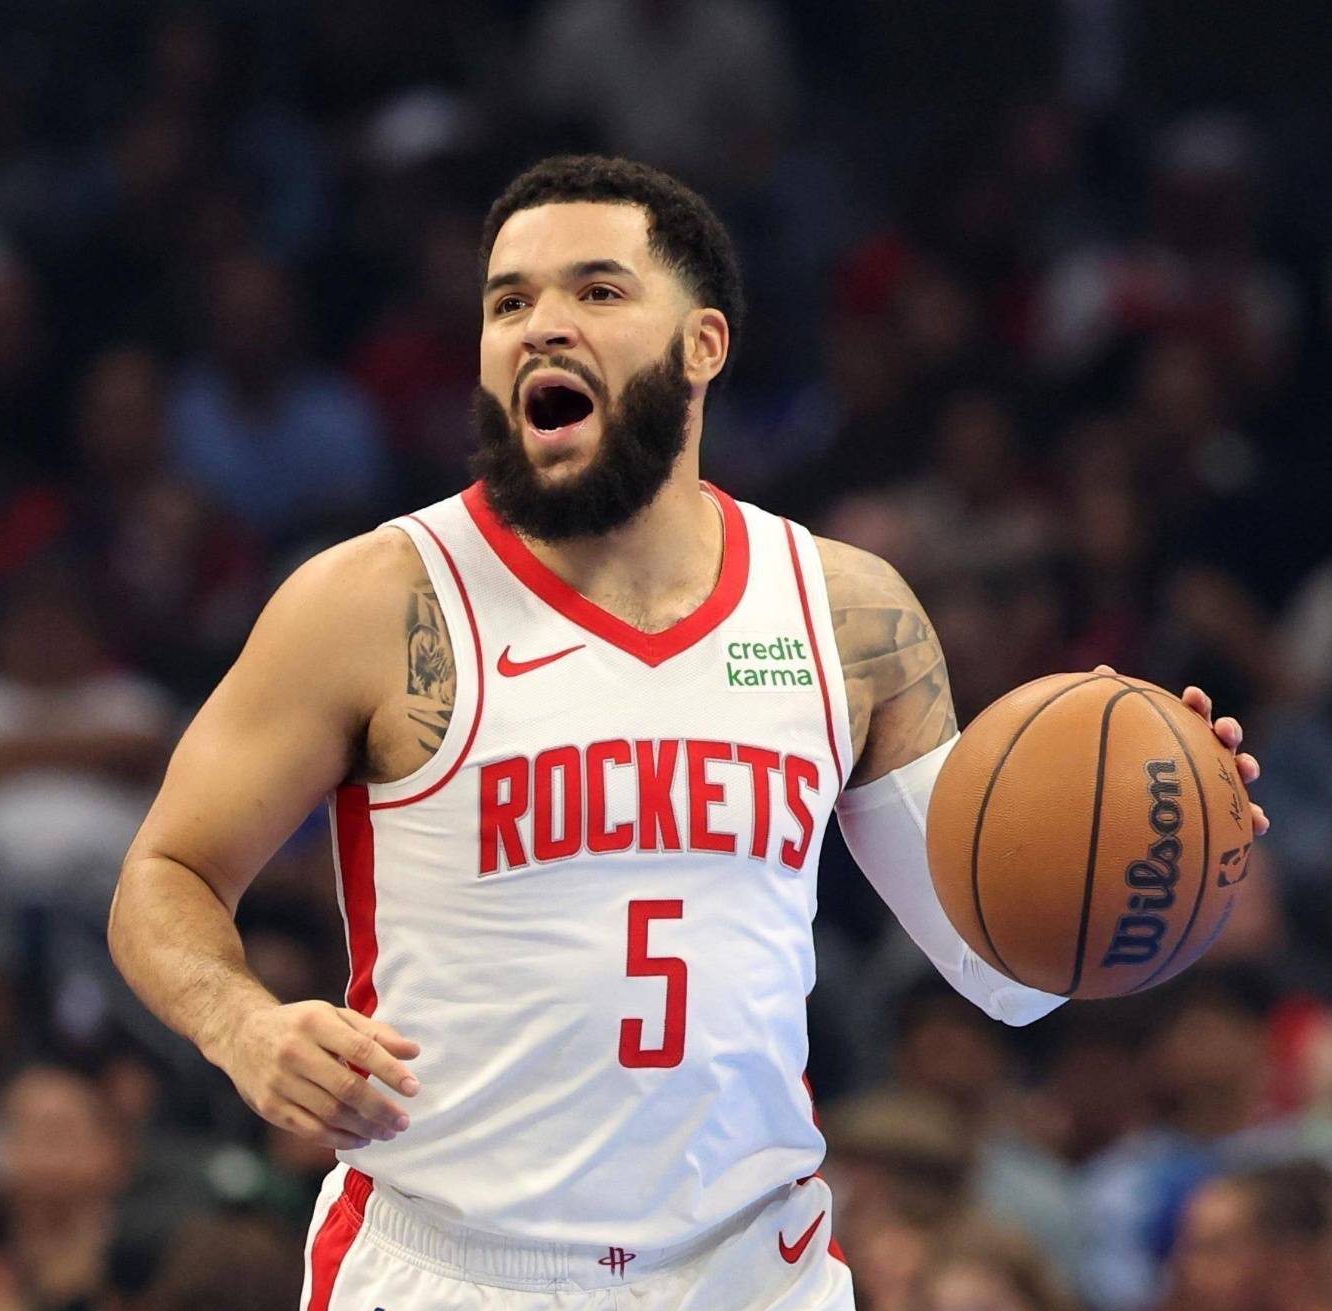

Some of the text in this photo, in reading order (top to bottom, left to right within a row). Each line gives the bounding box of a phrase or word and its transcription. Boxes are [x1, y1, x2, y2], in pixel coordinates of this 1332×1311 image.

[726, 661, 813, 687] karma
[727, 636, 807, 660] credit
[478, 738, 822, 877] ROCKETS
[1100, 758, 1183, 969] Wilson
[618, 898, 688, 1069] 5
